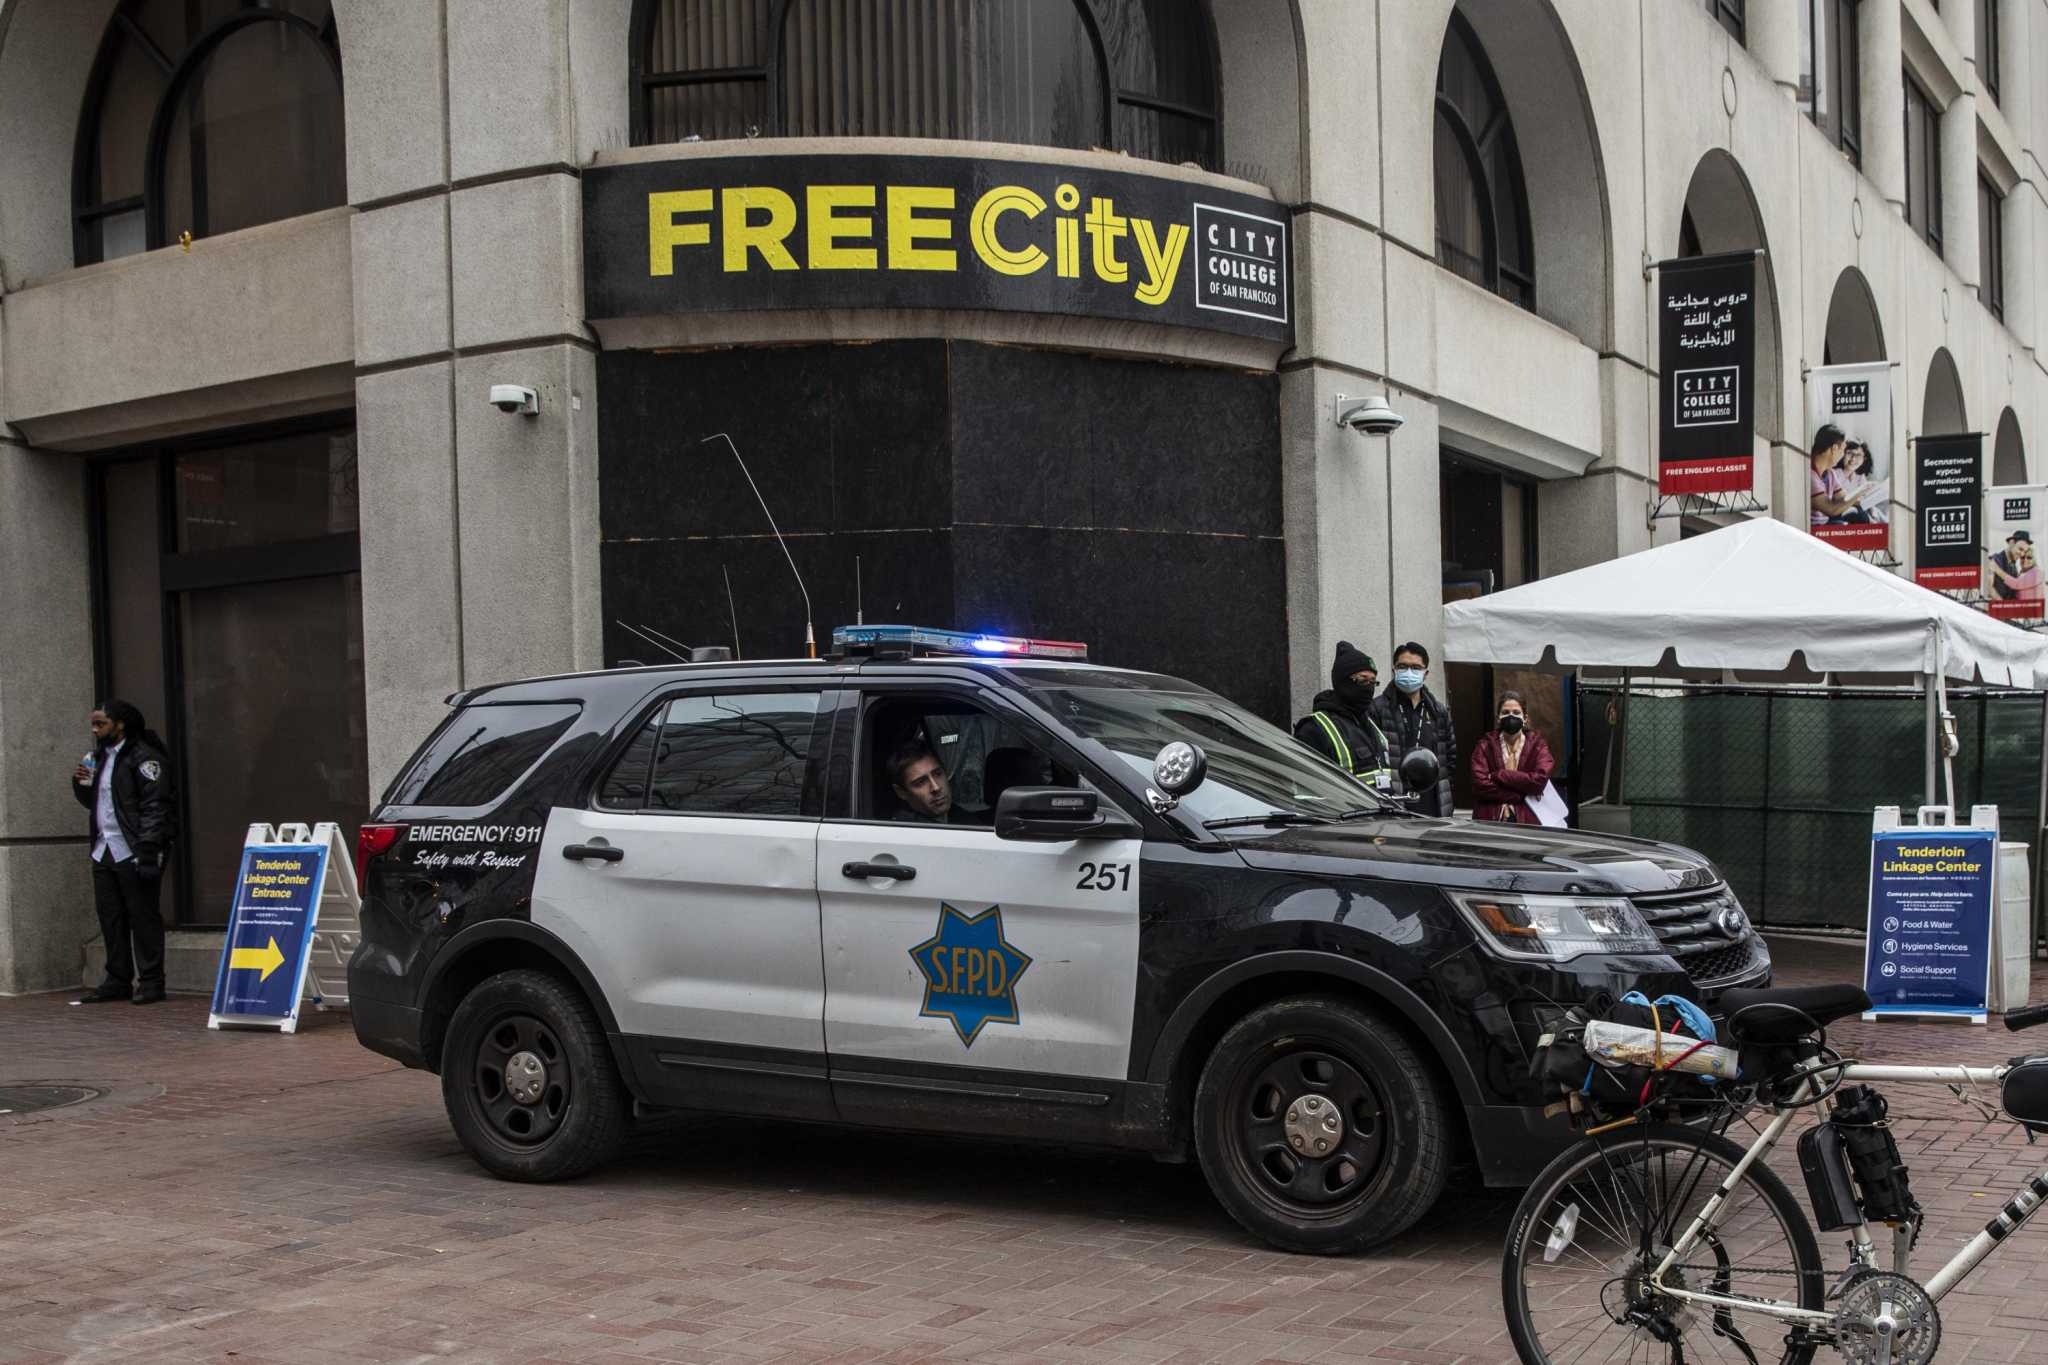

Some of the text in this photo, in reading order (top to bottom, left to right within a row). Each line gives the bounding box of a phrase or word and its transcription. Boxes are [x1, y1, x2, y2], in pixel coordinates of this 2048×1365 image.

[648, 183, 1190, 305] FREE City
[1208, 224, 1276, 257] CITY
[1208, 256, 1277, 287] COLLEGE
[1209, 281, 1277, 306] OF SAN FRANCISCO
[1668, 293, 1748, 311] دروس مجانية
[1683, 309, 1732, 328] في اللغة
[1683, 376, 1731, 391] CITY
[1836, 385, 1866, 395] CITY
[1683, 394, 1732, 407] COLLEGE
[1836, 395, 1866, 404] COLLEGE
[1683, 410, 1691, 419] OF
[1692, 409, 1703, 418] SAN
[1665, 464, 1747, 476] FREE ENGLISH CLASSES
[1931, 512, 1966, 522] CITY
[1931, 524, 1966, 533] COLLEGE
[408, 825, 541, 843] EMERGENCY 911
[1896, 846, 1966, 857] Tenderloin
[256, 860, 302, 870] Tenderloin
[413, 849, 526, 870] Safety with Respect
[1883, 861, 1981, 874] Linkage Center
[243, 874, 310, 886] Linkage Center
[1076, 863, 1131, 891] 251
[251, 887, 292, 898] Entrance
[1903, 920, 1954, 929] Food & Water
[1901, 942, 1969, 952] Hygiene Services
[931, 946, 1008, 998] S.F.P.D.
[1900, 965, 1957, 975] Social Support
